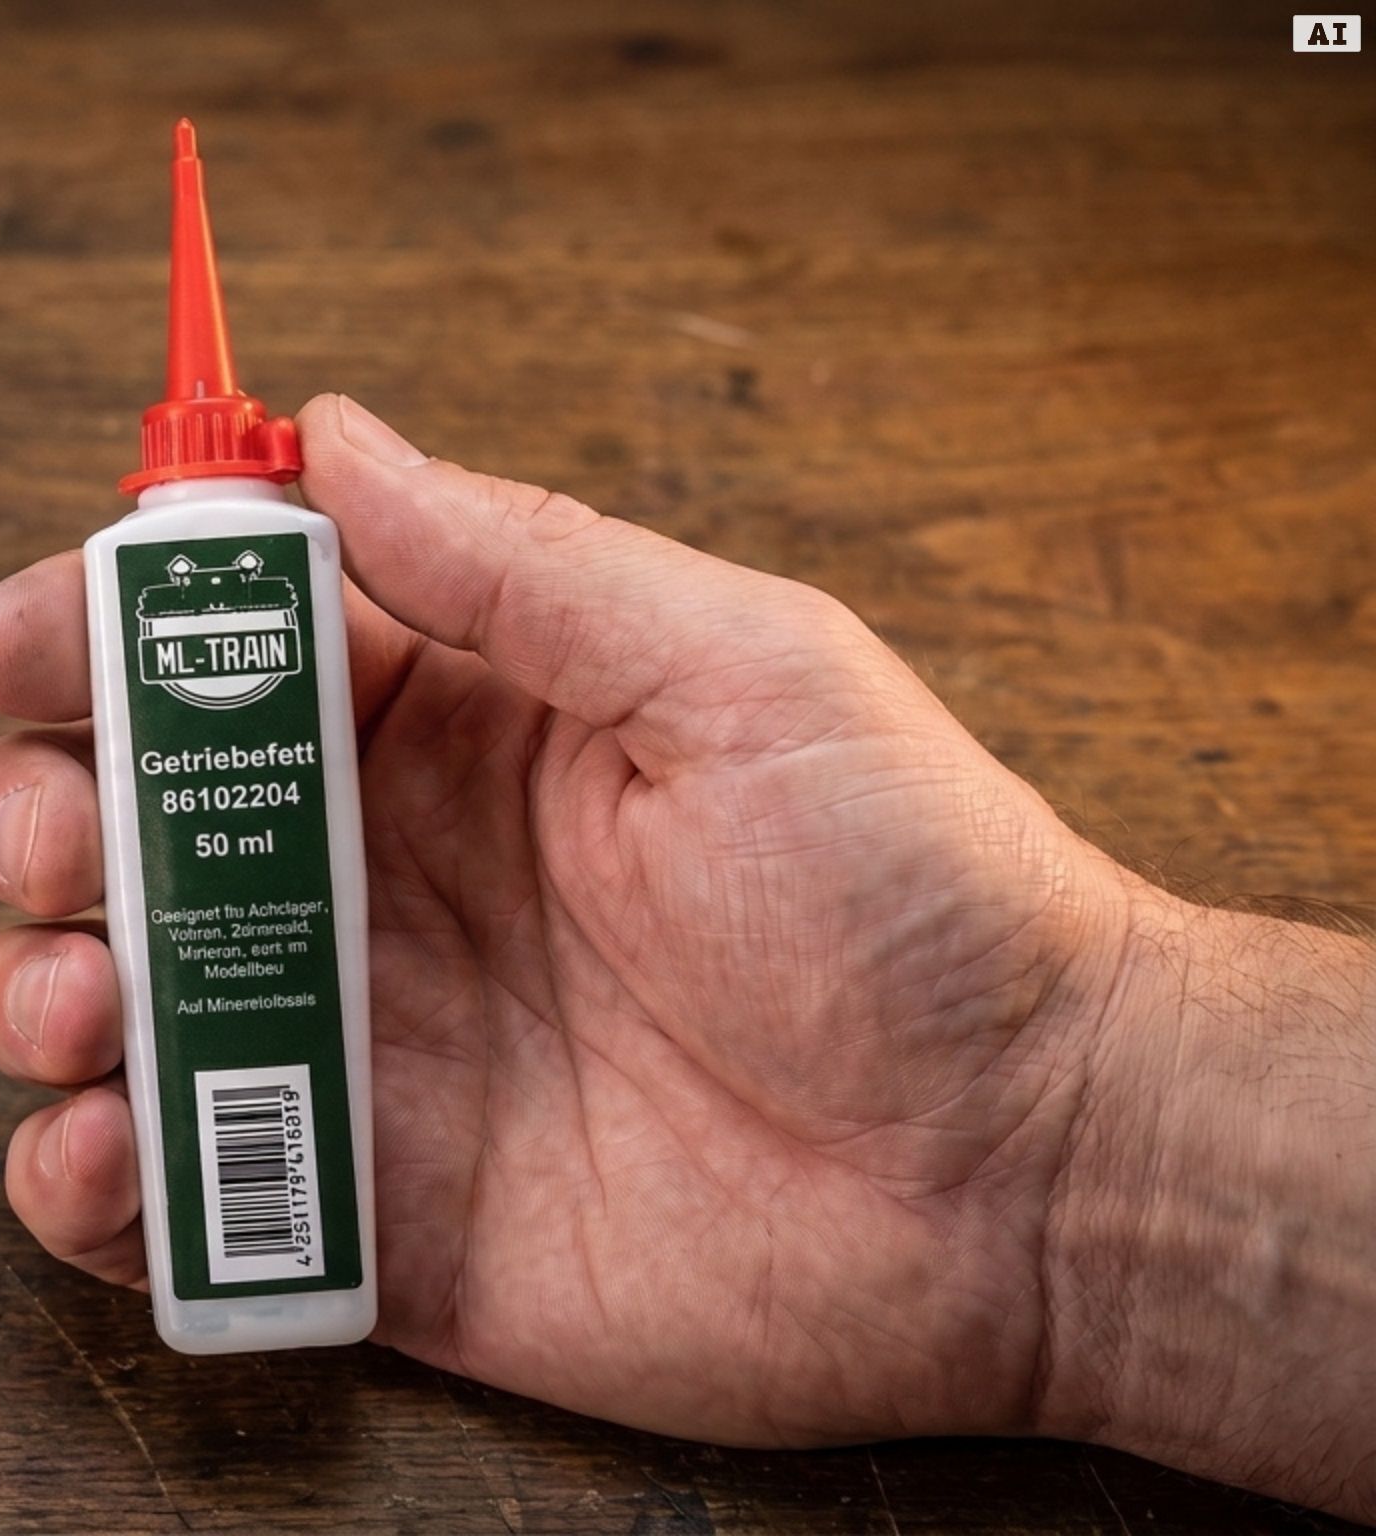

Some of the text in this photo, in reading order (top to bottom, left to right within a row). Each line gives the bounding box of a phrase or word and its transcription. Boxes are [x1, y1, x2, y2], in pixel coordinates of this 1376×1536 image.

[156, 633, 287, 675] ML-TRAIN
[140, 741, 316, 775] Getriebefett
[162, 781, 301, 814] 86102204
[195, 829, 274, 858] 50 ml
